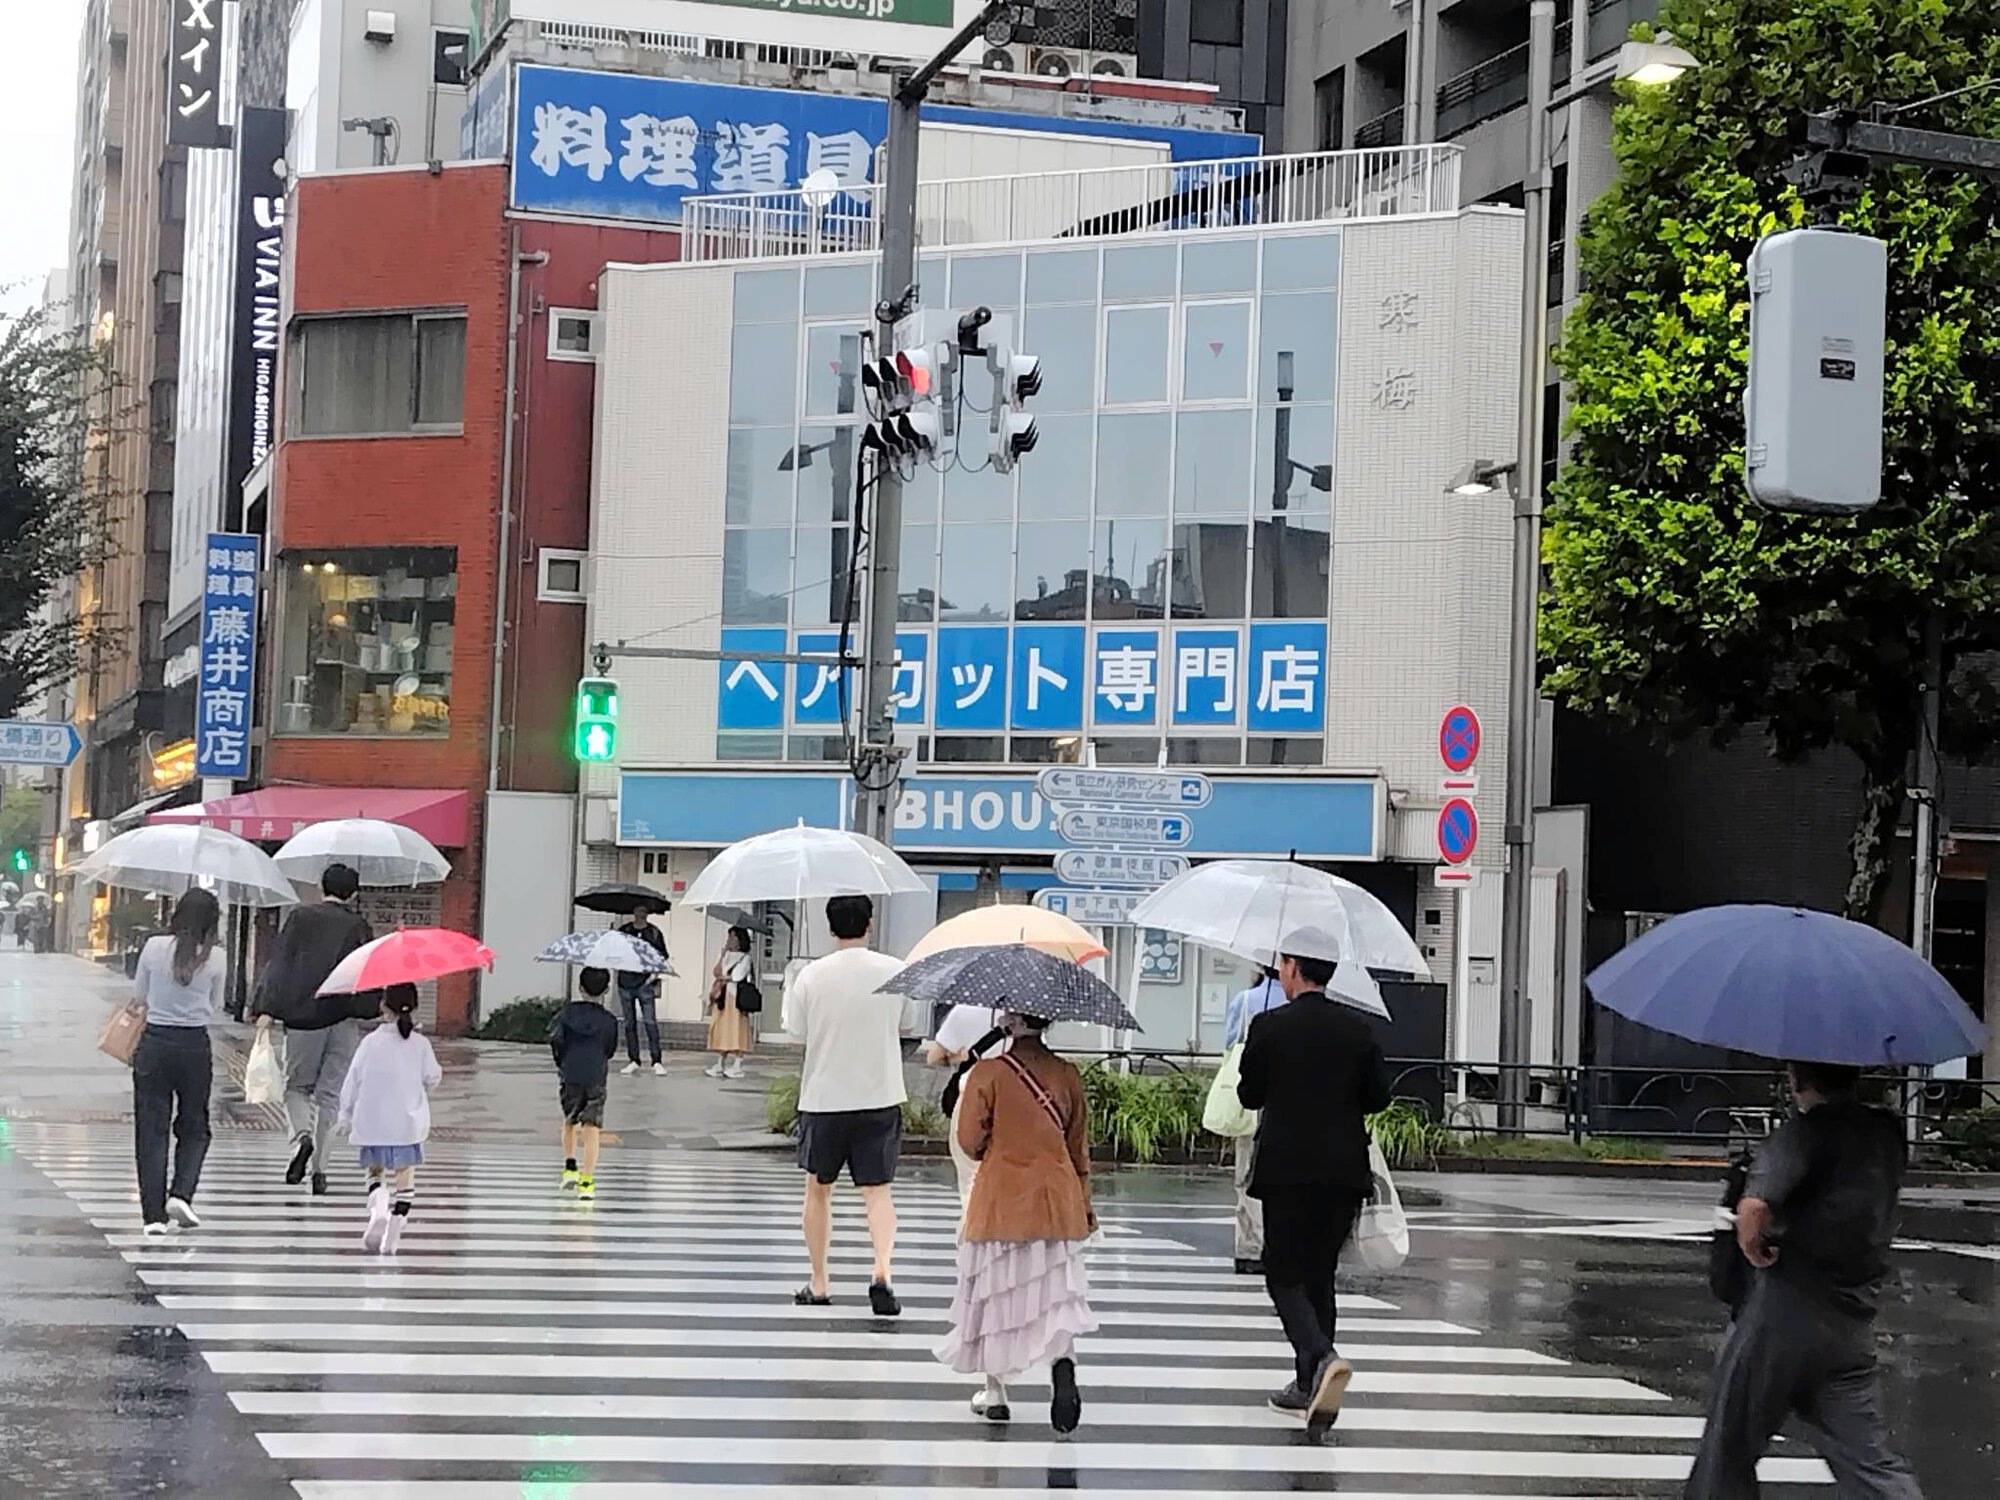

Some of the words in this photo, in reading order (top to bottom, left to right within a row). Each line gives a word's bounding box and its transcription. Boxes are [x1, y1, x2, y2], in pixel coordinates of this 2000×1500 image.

[530, 101, 873, 203] 料理道具
[255, 238, 281, 288] VIA
[252, 296, 278, 349] INN
[200, 606, 250, 766] 藤井商店
[726, 645, 1321, 713] ヘアカット専門店
[0, 727, 62, 746] 橋通り
[851, 790, 1068, 832] BHOU
